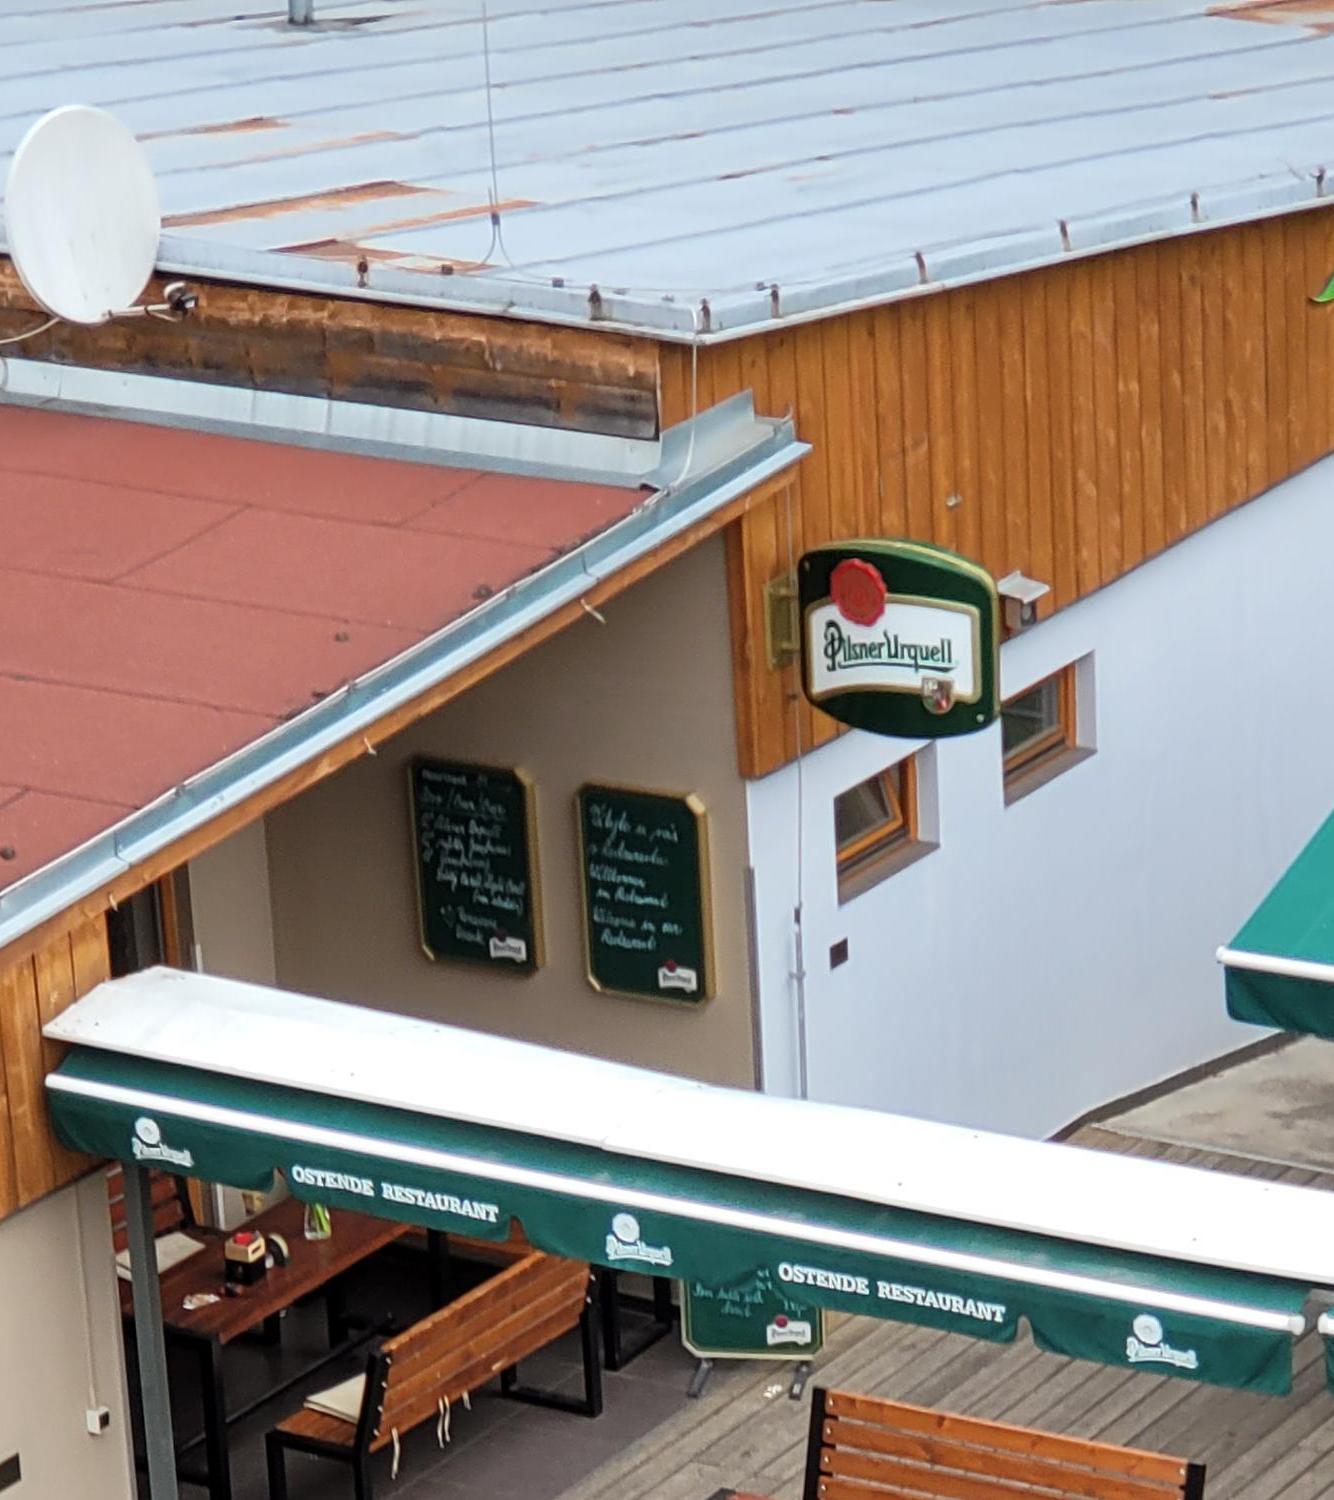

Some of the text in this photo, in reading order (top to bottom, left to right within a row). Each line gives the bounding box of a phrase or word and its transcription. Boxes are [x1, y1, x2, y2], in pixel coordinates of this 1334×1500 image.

[824, 619, 953, 673] Pilsner Urquell
[291, 1165, 500, 1223] OSTENDE RESTAURANT
[778, 1262, 870, 1297] OSTENDE
[876, 1280, 1007, 1324] RESTAURANT
